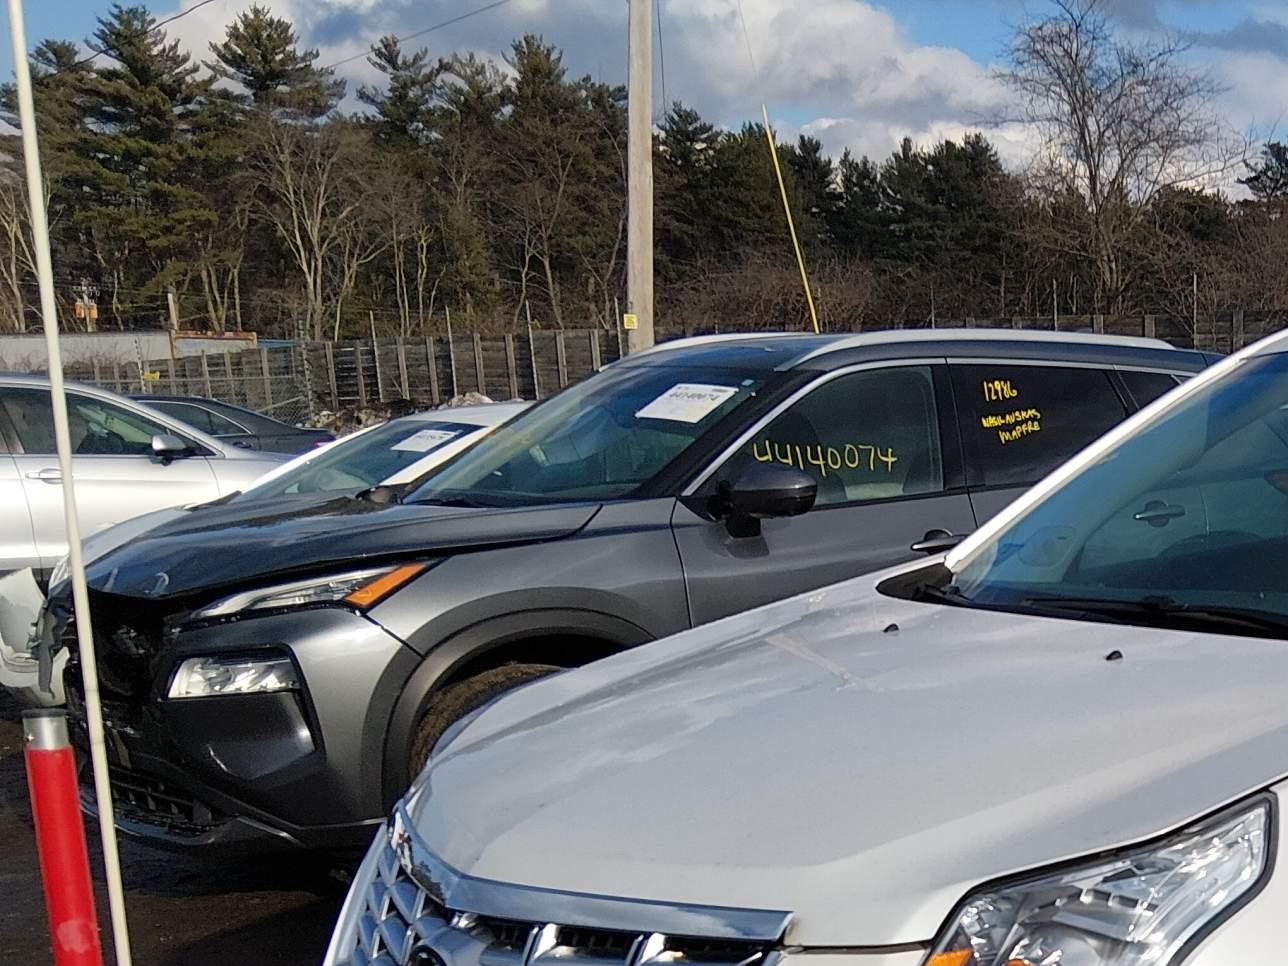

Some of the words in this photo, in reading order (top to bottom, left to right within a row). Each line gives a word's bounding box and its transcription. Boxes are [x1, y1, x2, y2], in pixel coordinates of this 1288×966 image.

[983, 380, 1018, 402] 12986
[998, 420, 1041, 445] MAPFRE
[753, 440, 897, 476] 44140074
